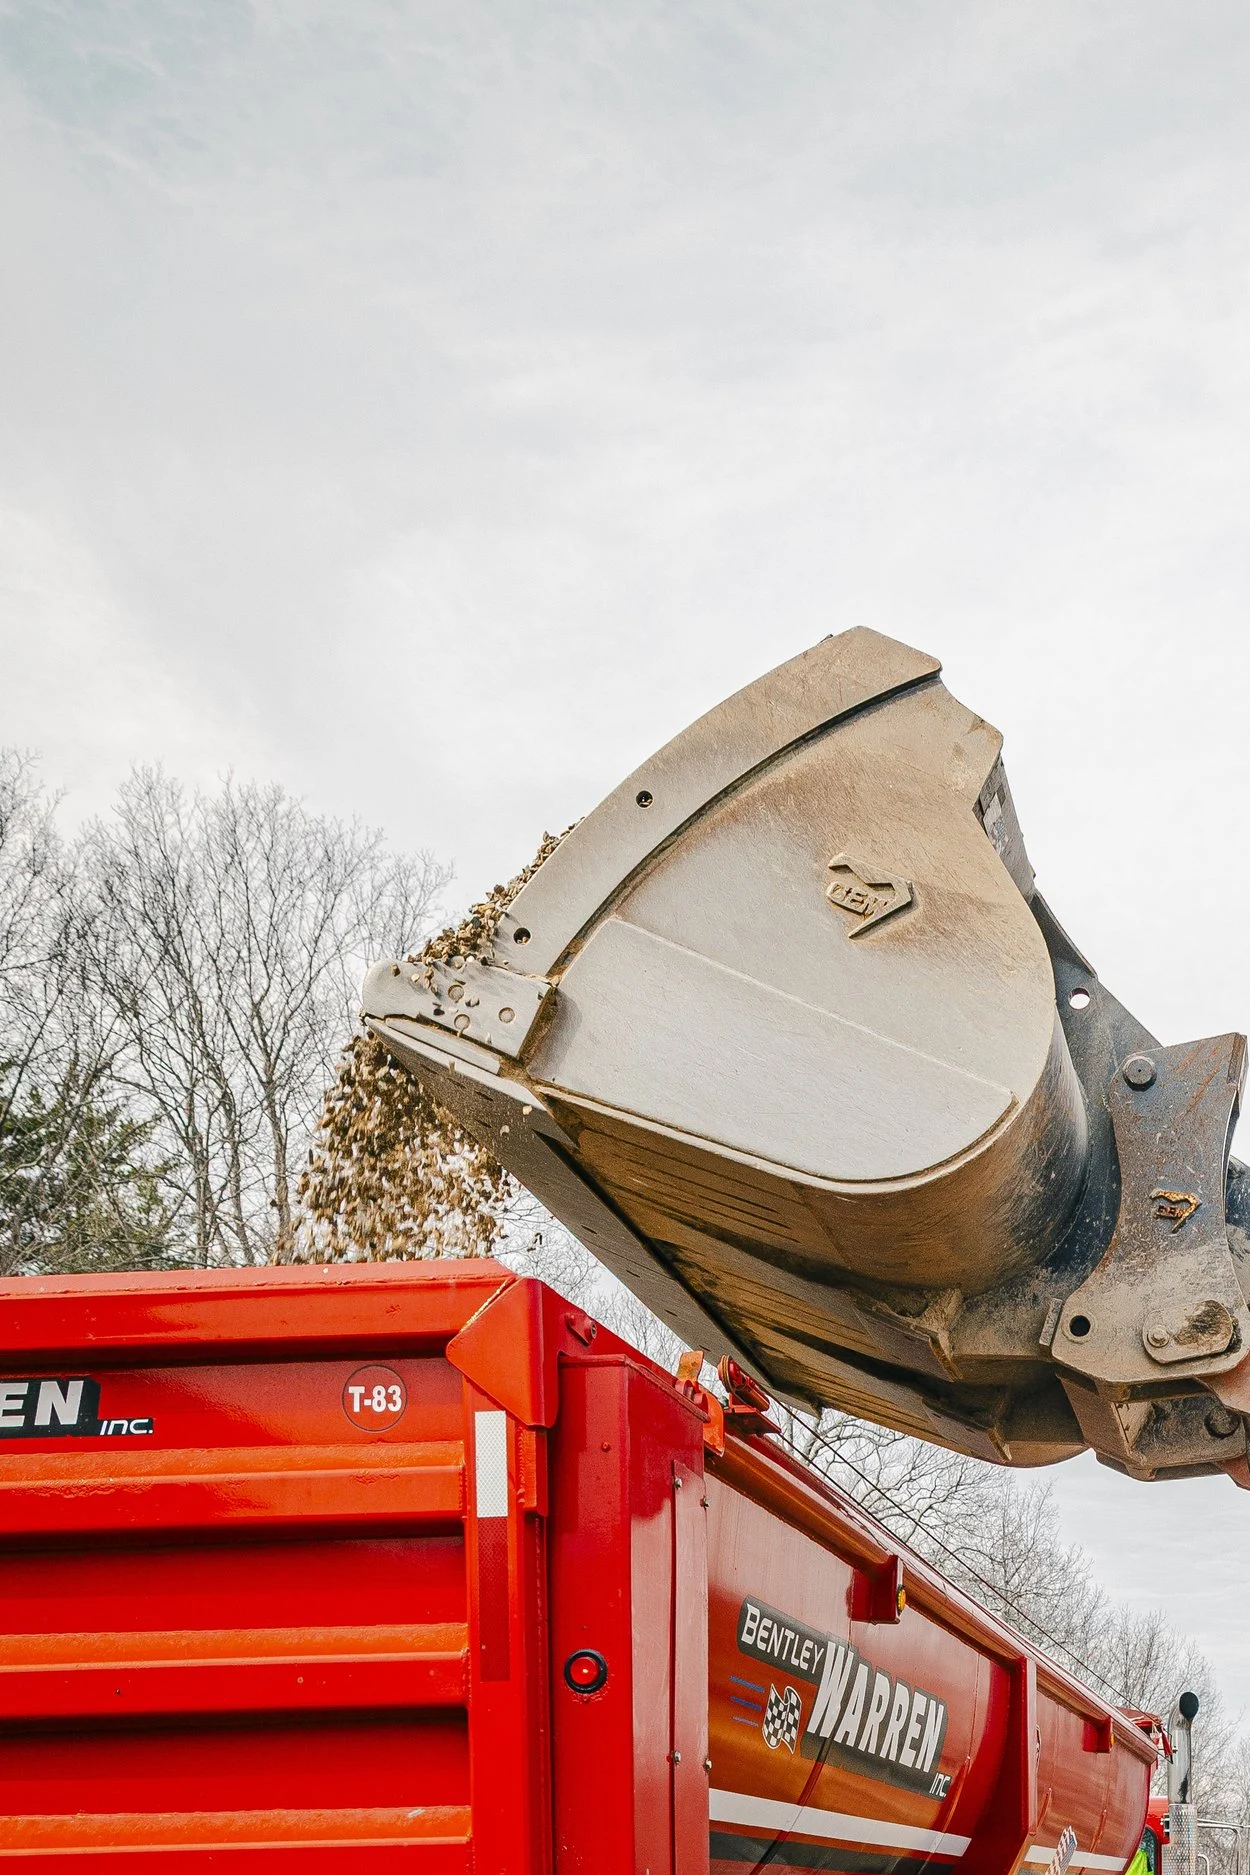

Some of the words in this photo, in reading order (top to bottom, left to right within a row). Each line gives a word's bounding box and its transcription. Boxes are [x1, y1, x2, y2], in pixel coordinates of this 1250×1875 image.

[0, 1381, 84, 1427] EN
[348, 1385, 402, 1413] T-83
[741, 1602, 825, 1674] BENTLEY
[807, 1640, 945, 1773] WARREN
